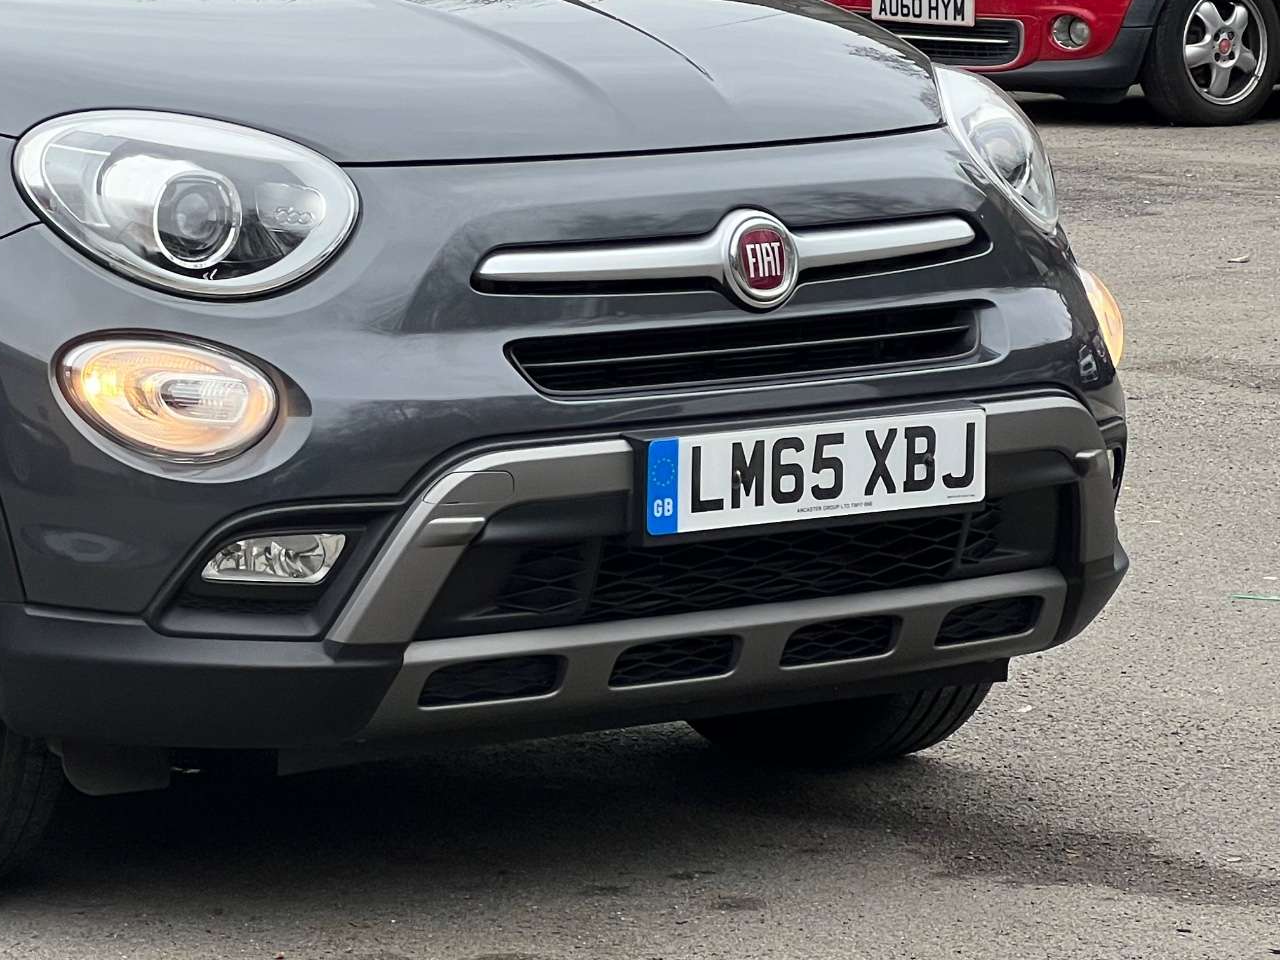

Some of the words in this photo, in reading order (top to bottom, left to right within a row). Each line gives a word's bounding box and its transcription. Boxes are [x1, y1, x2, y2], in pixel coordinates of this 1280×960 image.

[745, 242, 781, 278] FIAT
[690, 432, 845, 514] LM65
[864, 422, 976, 496] XBJ
[653, 497, 673, 518] GB
